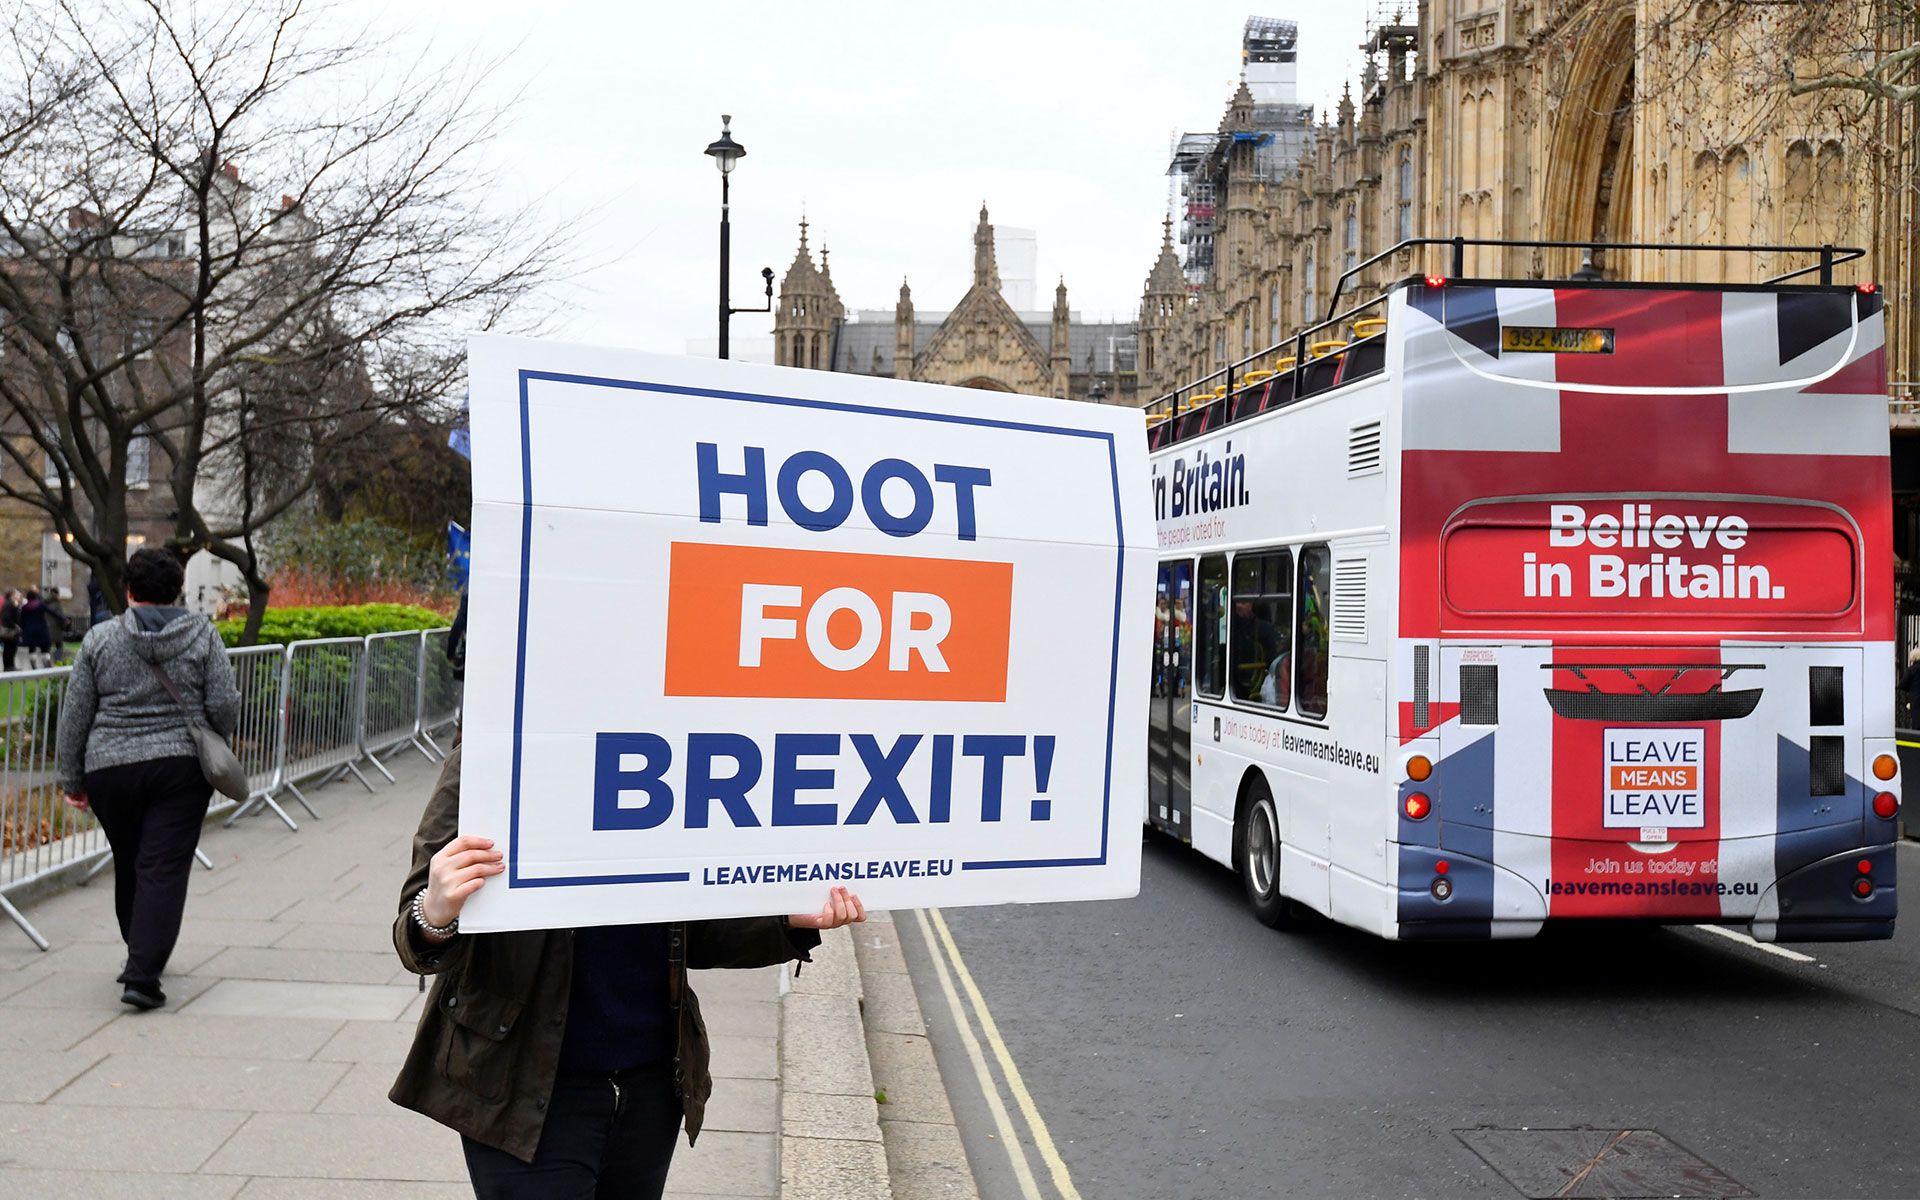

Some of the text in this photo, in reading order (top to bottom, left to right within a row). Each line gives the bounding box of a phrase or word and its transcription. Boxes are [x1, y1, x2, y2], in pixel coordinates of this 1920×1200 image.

[696, 441, 991, 541] HOOT
[1172, 440, 1249, 518] Britain.
[1550, 504, 1748, 549] Believe
[1523, 552, 1785, 600] in Britain.
[738, 584, 952, 673] FOR
[1223, 715, 1379, 774] Join us today at leavemeansleave.eu
[1610, 741, 1697, 762] LEAVE
[593, 732, 1056, 831] BREXIT!
[1620, 770, 1687, 786] MEANS
[1610, 794, 1697, 815] LEAVE
[703, 859, 953, 886] LEAVEMEANSLEAVE.EU
[1545, 878, 1759, 896] leavemeansleave.eu
[1584, 858, 1718, 877] Join us today at
